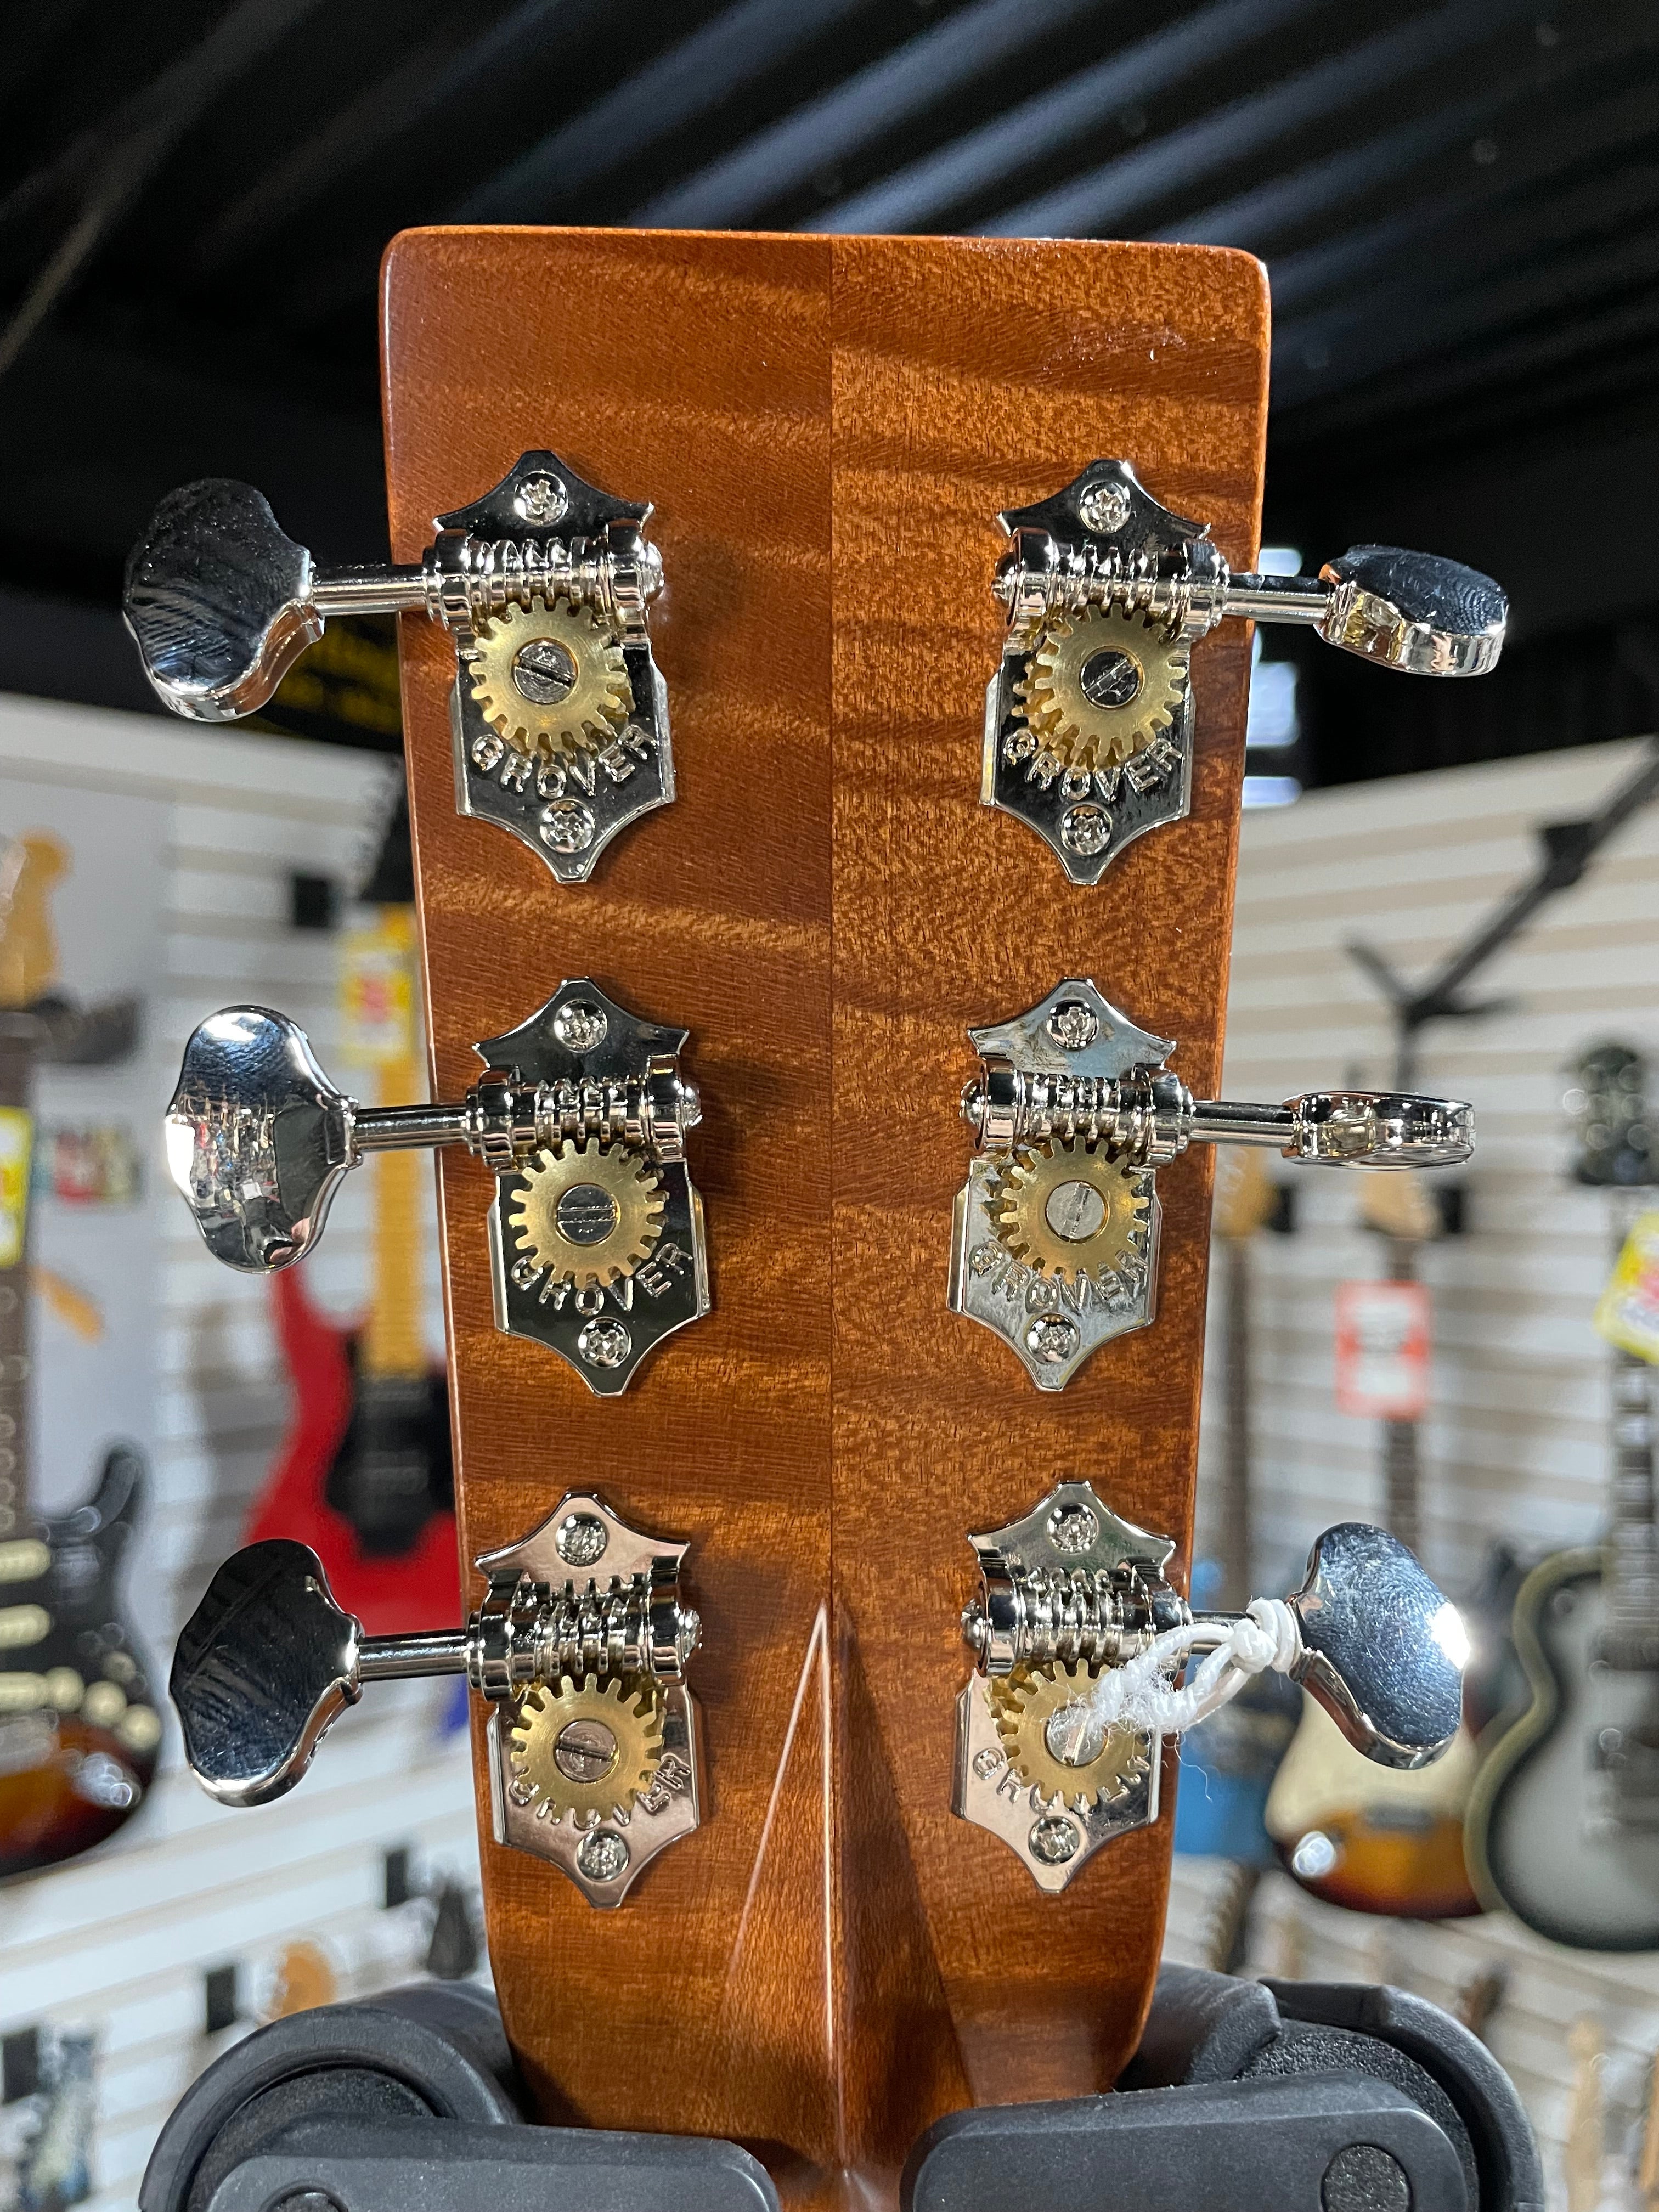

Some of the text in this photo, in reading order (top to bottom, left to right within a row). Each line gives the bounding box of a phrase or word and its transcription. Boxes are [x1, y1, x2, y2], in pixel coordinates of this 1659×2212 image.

[472, 724, 659, 799] GROVER
[1003, 729, 1183, 802] GROVER
[511, 1243, 693, 1316] GROVER
[971, 1241, 1148, 1311] GROVER
